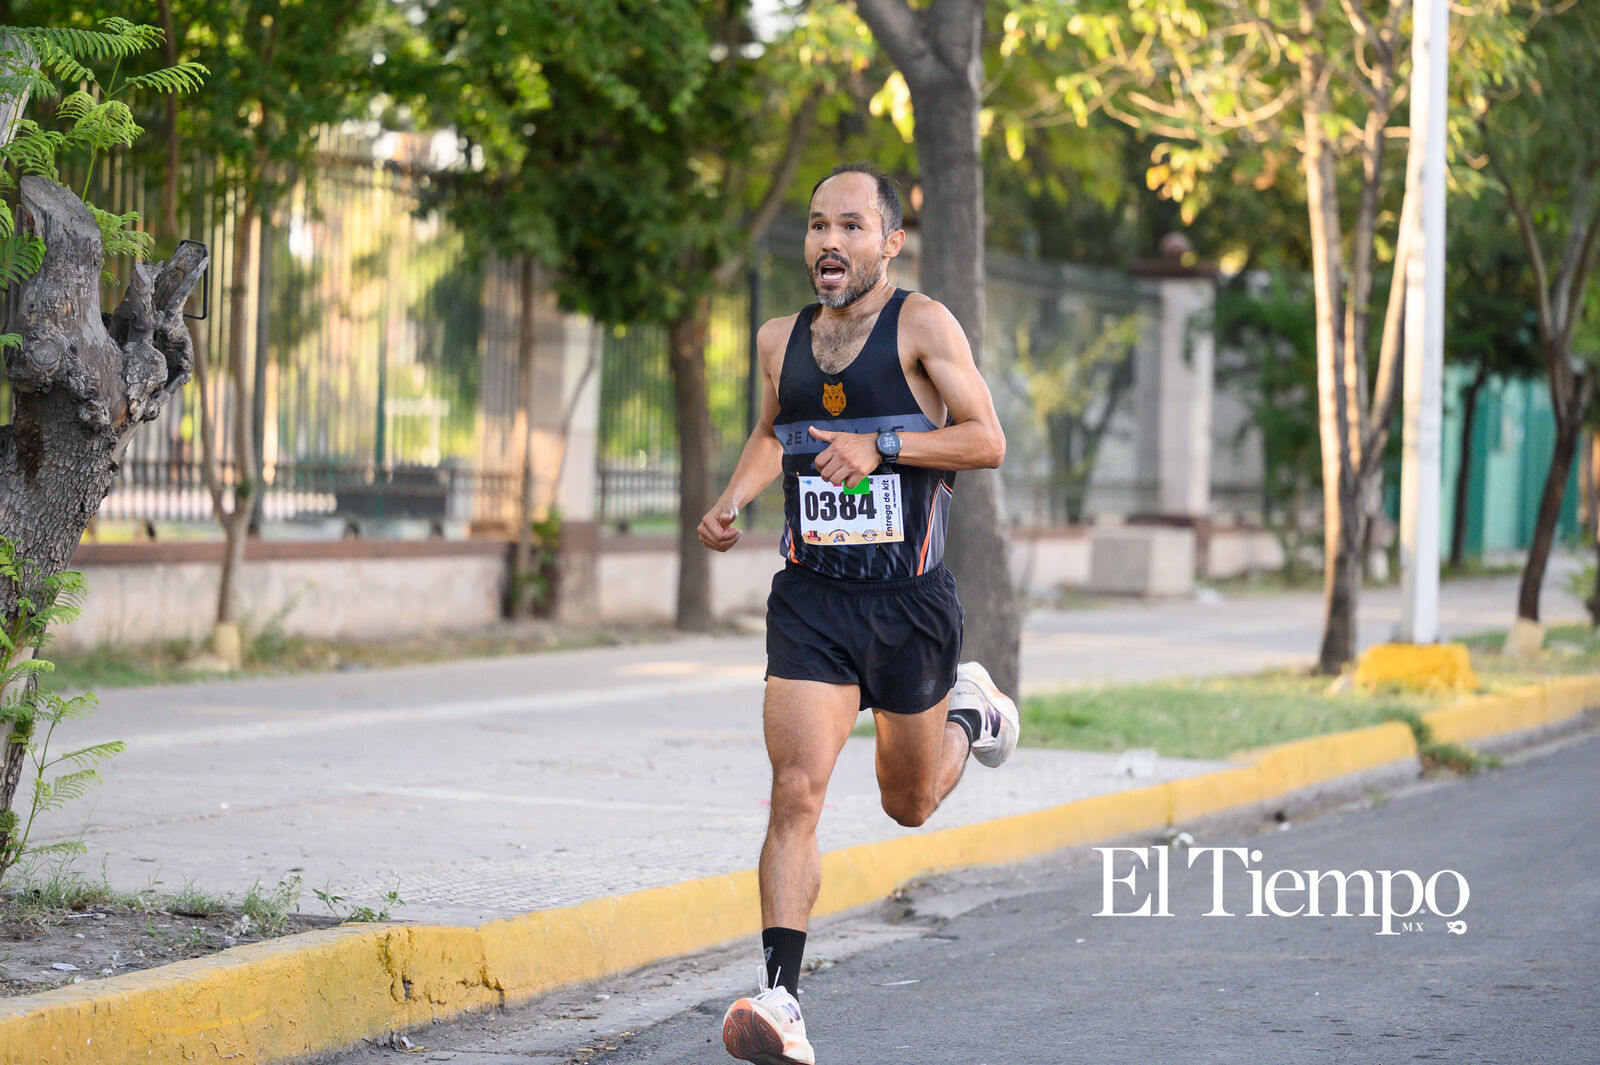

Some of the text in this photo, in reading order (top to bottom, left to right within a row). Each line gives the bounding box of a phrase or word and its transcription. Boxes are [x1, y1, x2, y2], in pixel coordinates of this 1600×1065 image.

[804, 491, 877, 521] 0384
[881, 479, 893, 537] Entrega de kit
